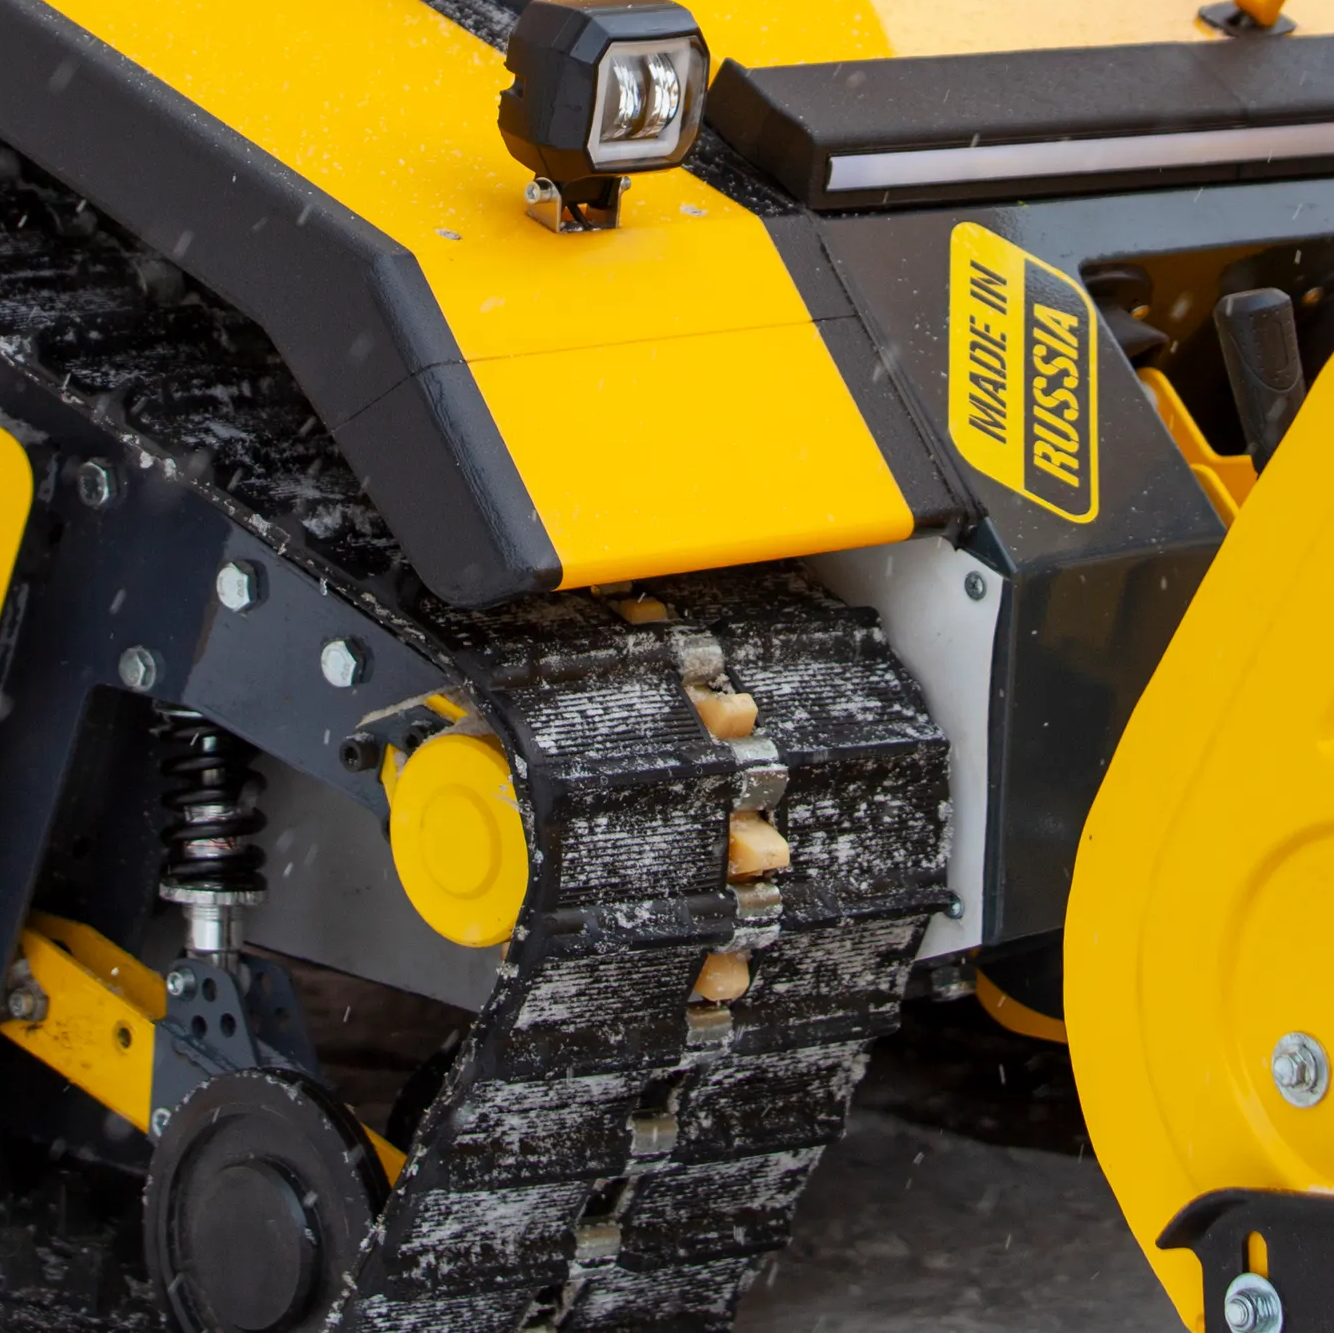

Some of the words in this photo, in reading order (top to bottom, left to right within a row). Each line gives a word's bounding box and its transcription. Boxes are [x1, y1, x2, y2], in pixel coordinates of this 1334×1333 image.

[970, 260, 1007, 315] IN
[969, 314, 1007, 444] MADE
[1033, 303, 1080, 488] RUSSIA
